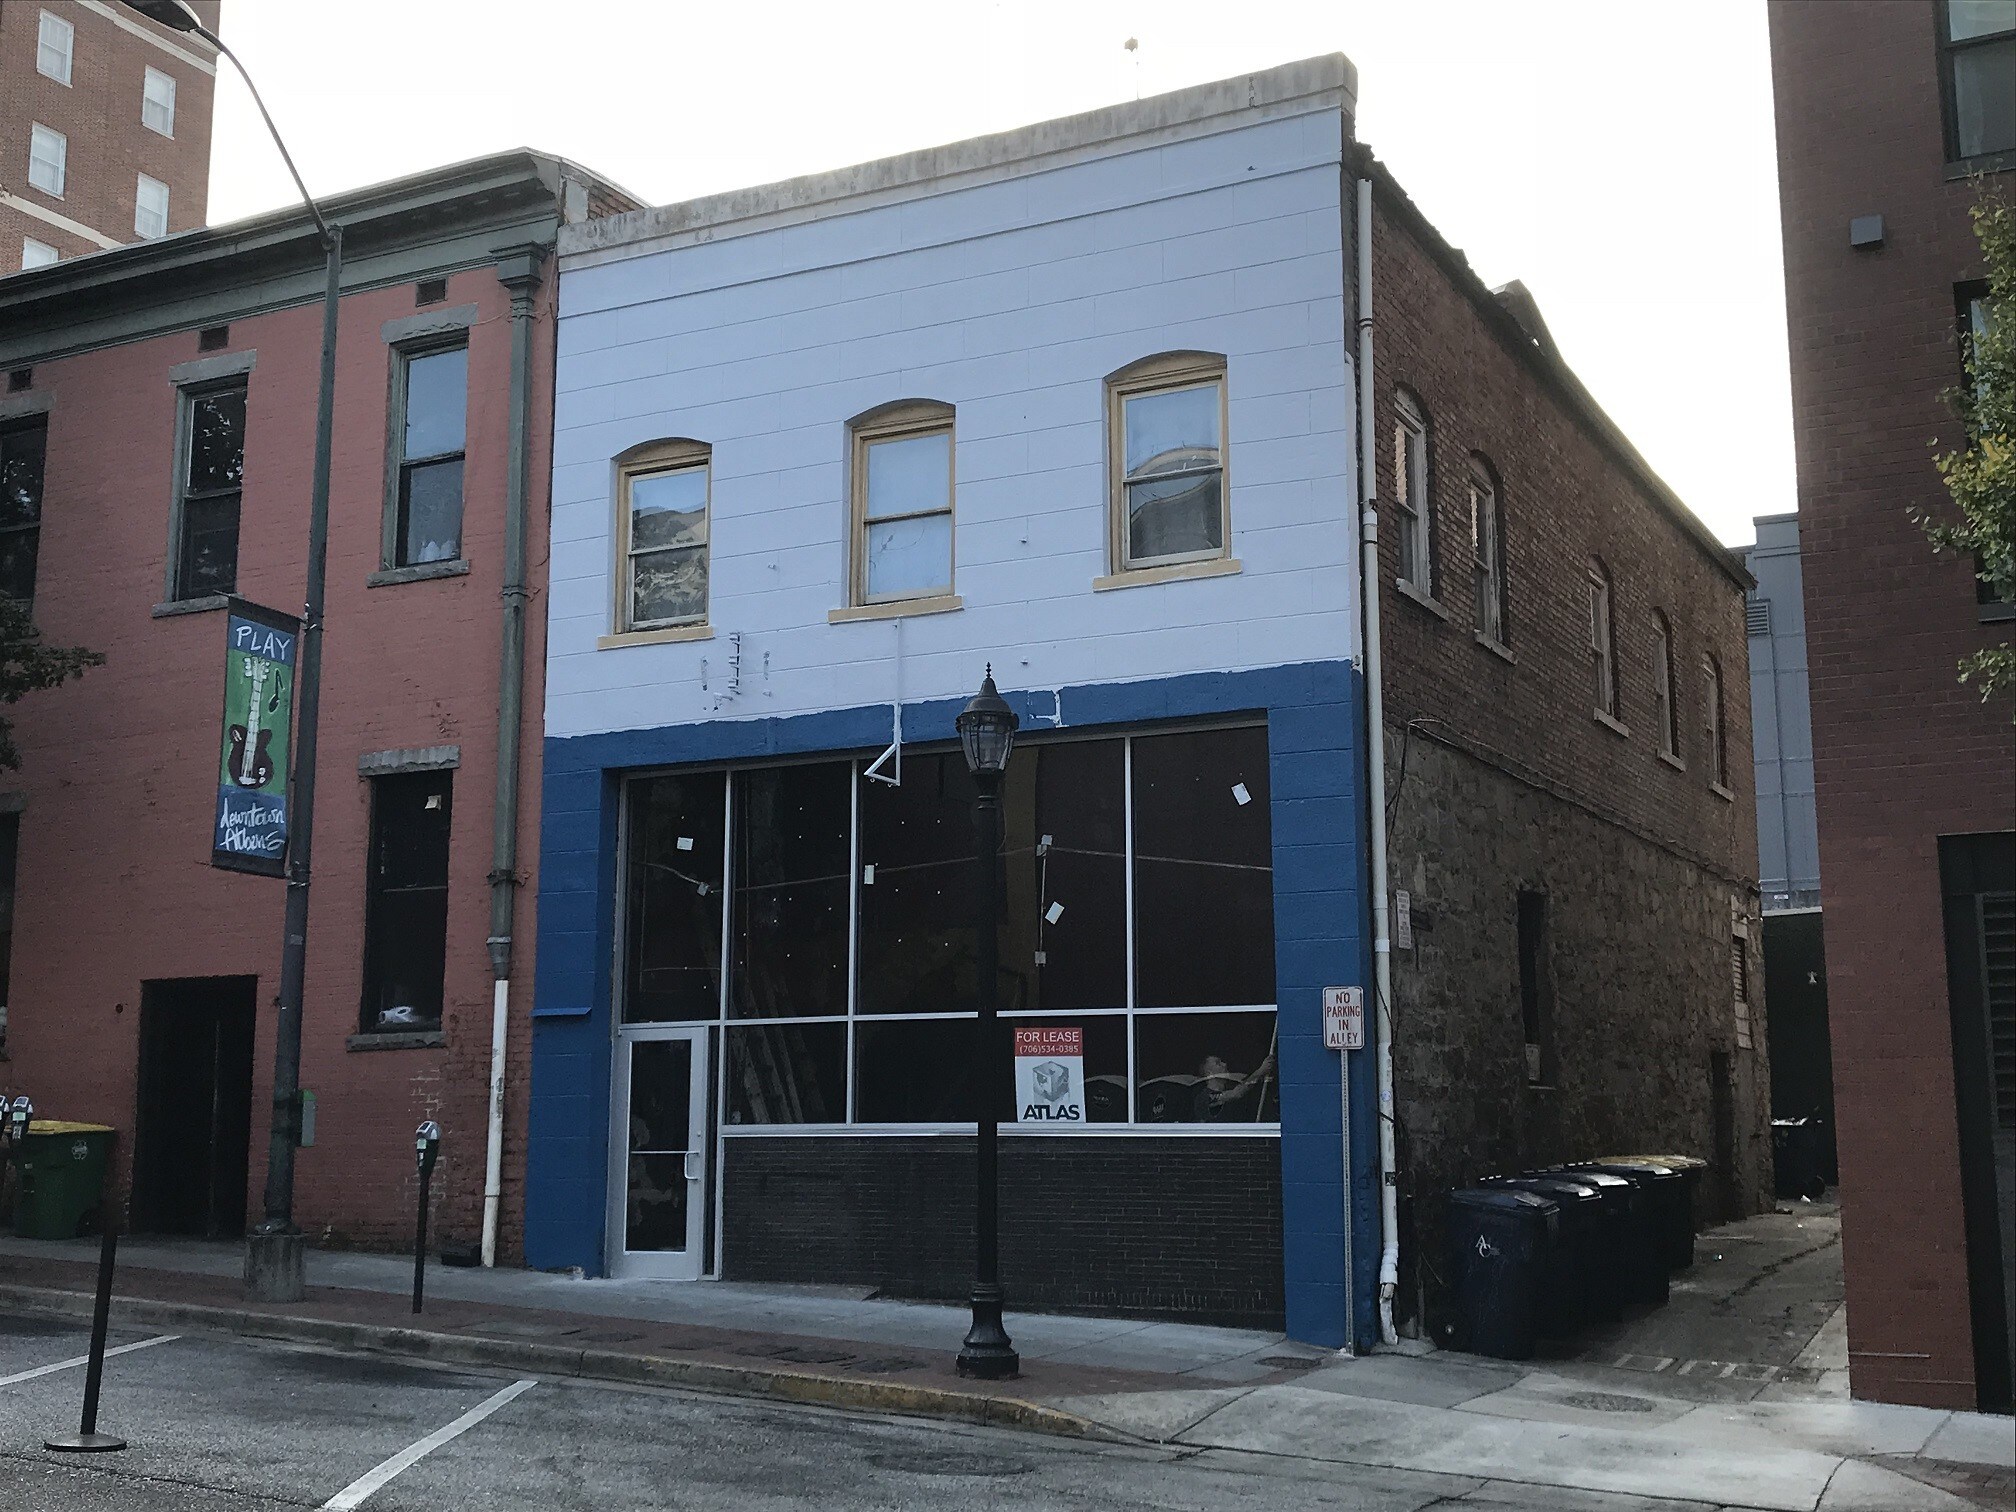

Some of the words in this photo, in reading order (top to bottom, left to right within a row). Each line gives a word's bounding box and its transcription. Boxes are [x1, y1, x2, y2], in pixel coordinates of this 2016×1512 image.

[236, 625, 290, 664] PLAY
[220, 798, 285, 829] downtown
[220, 826, 286, 852] Athens
[1336, 992, 1351, 1004] NO
[1326, 1005, 1361, 1018] PARKING
[1338, 1019, 1349, 1031] IN
[1016, 1031, 1040, 1043] FOR
[1043, 1031, 1080, 1043] LEASE
[1330, 1032, 1358, 1045] ALLEY
[1023, 1104, 1080, 1121] ATLAS
